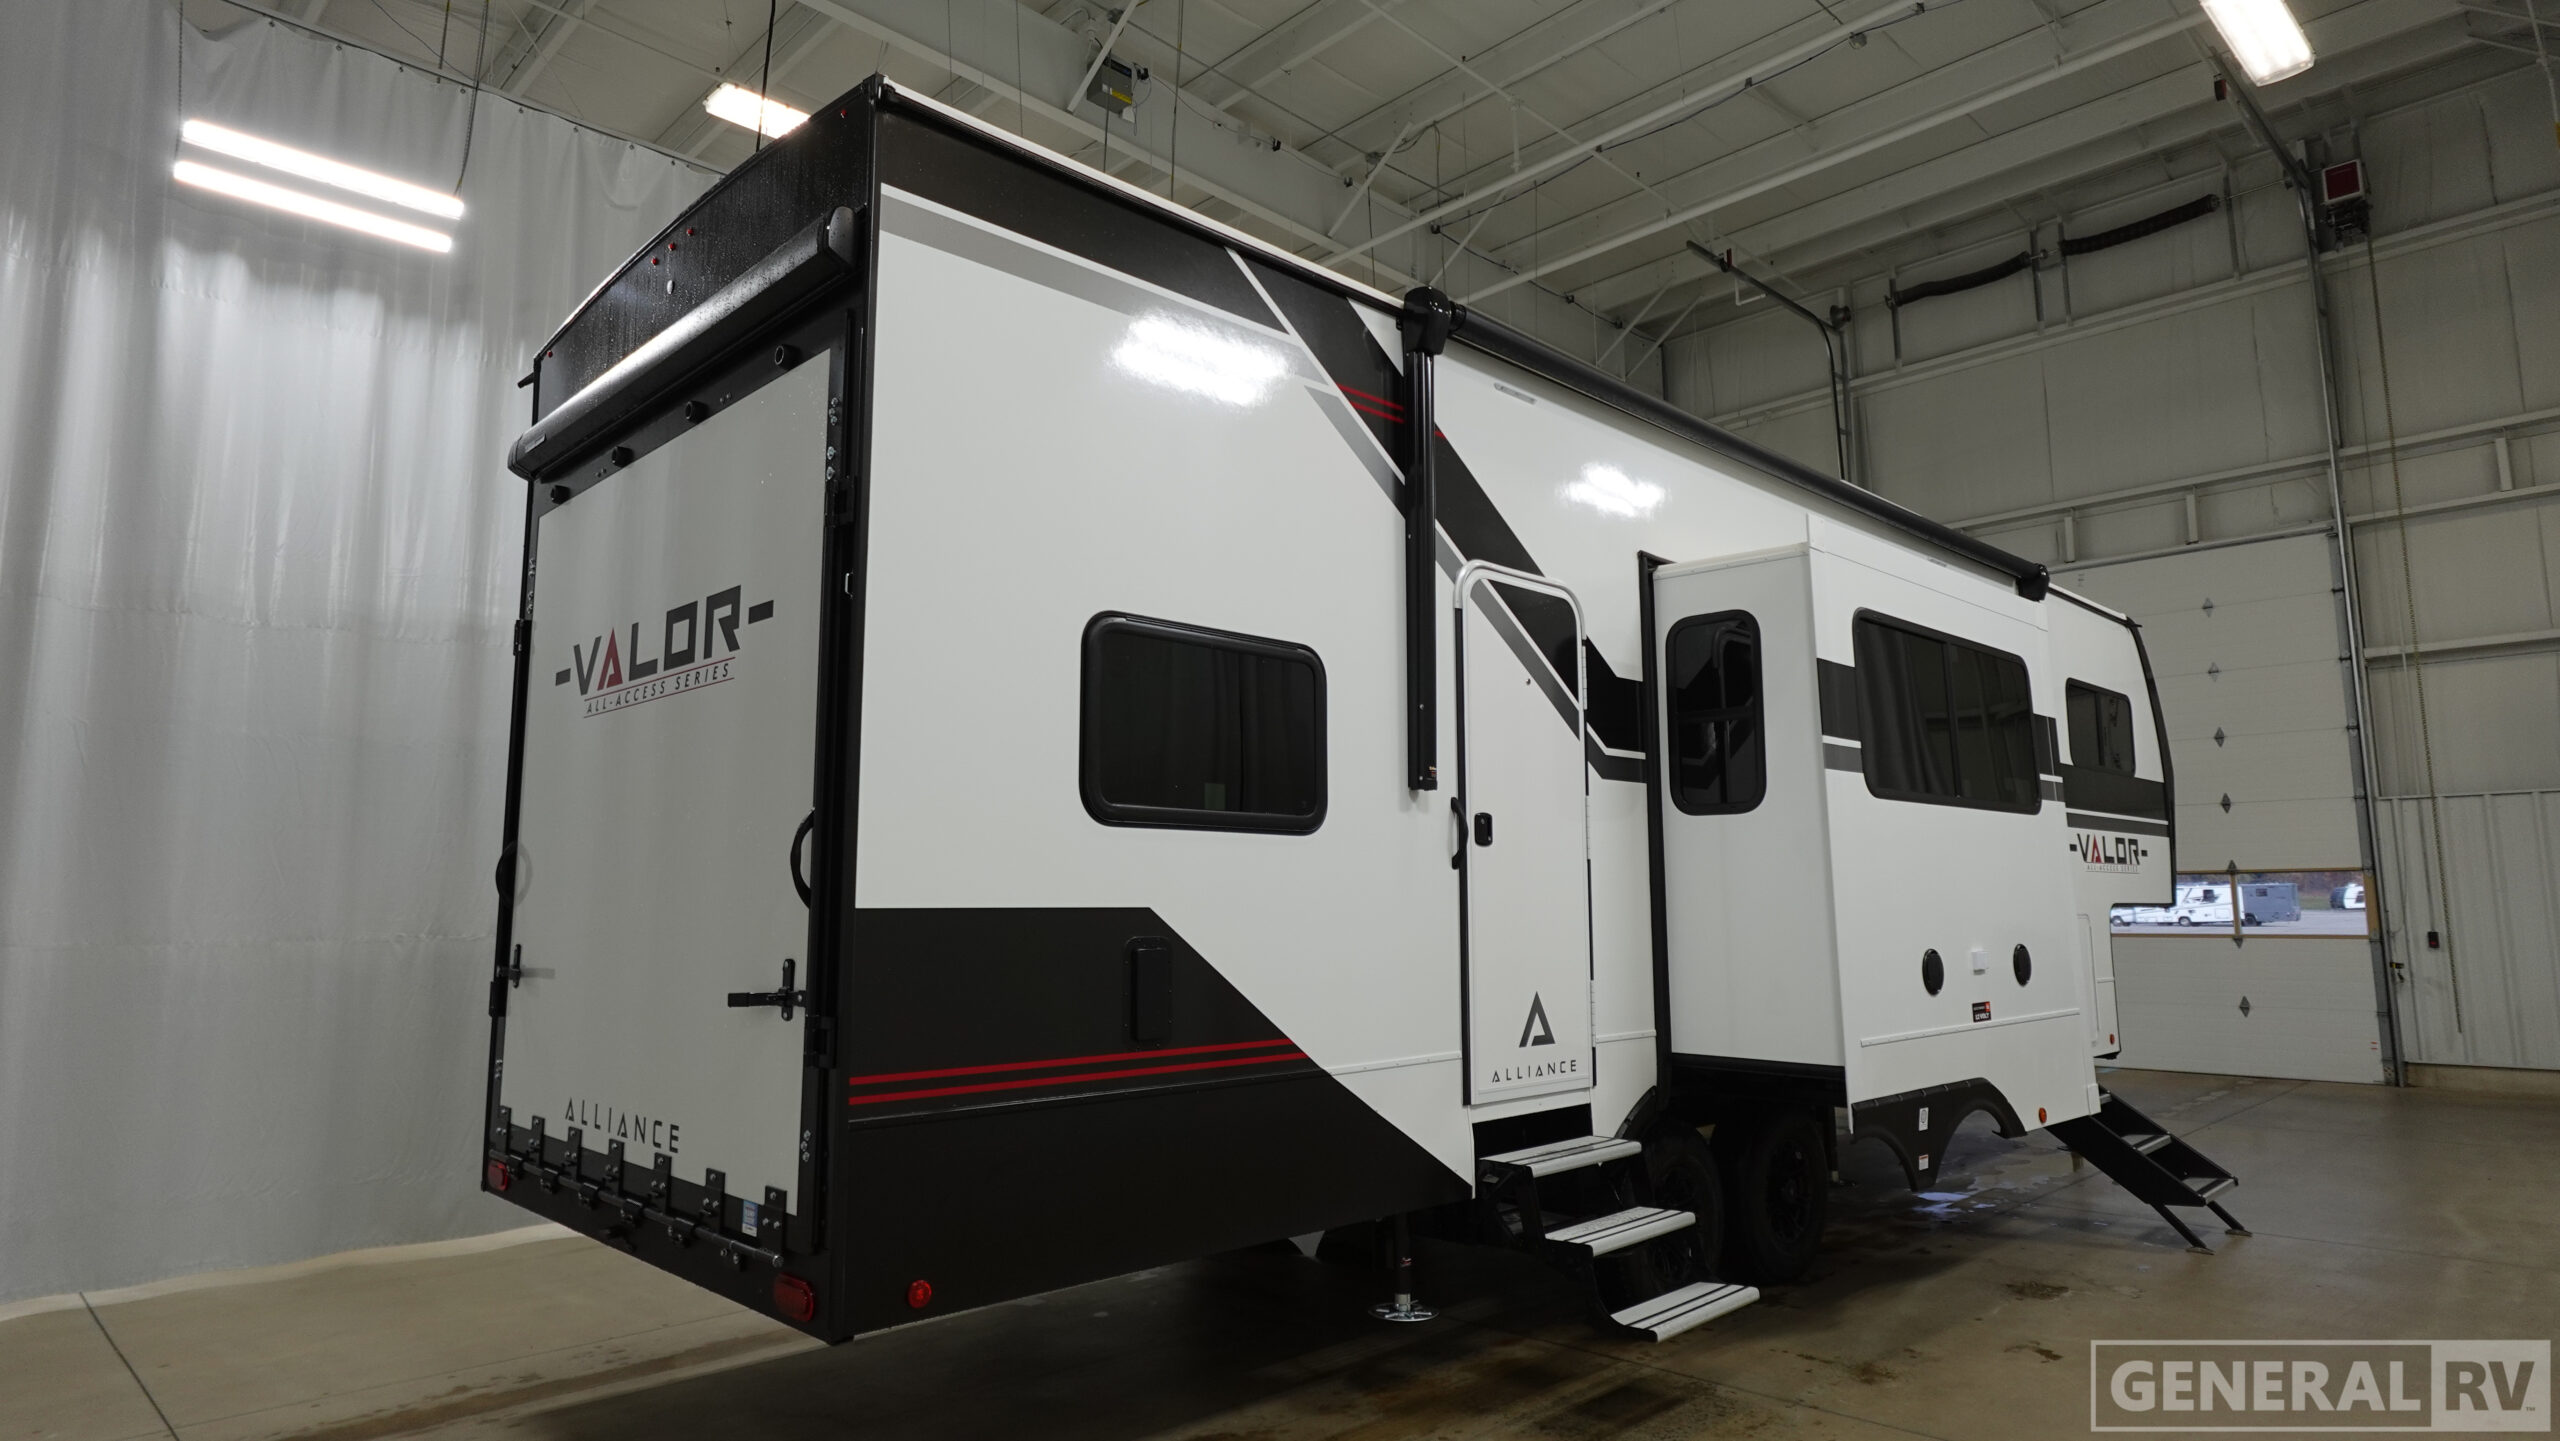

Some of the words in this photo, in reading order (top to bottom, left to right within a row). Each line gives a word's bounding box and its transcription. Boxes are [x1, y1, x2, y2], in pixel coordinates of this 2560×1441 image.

[586, 680, 666, 715] ALL-ACCESS
[674, 663, 730, 690] SERIES
[1491, 1059, 1577, 1083] ALLIANCE
[565, 1097, 680, 1154] ALLIANCE
